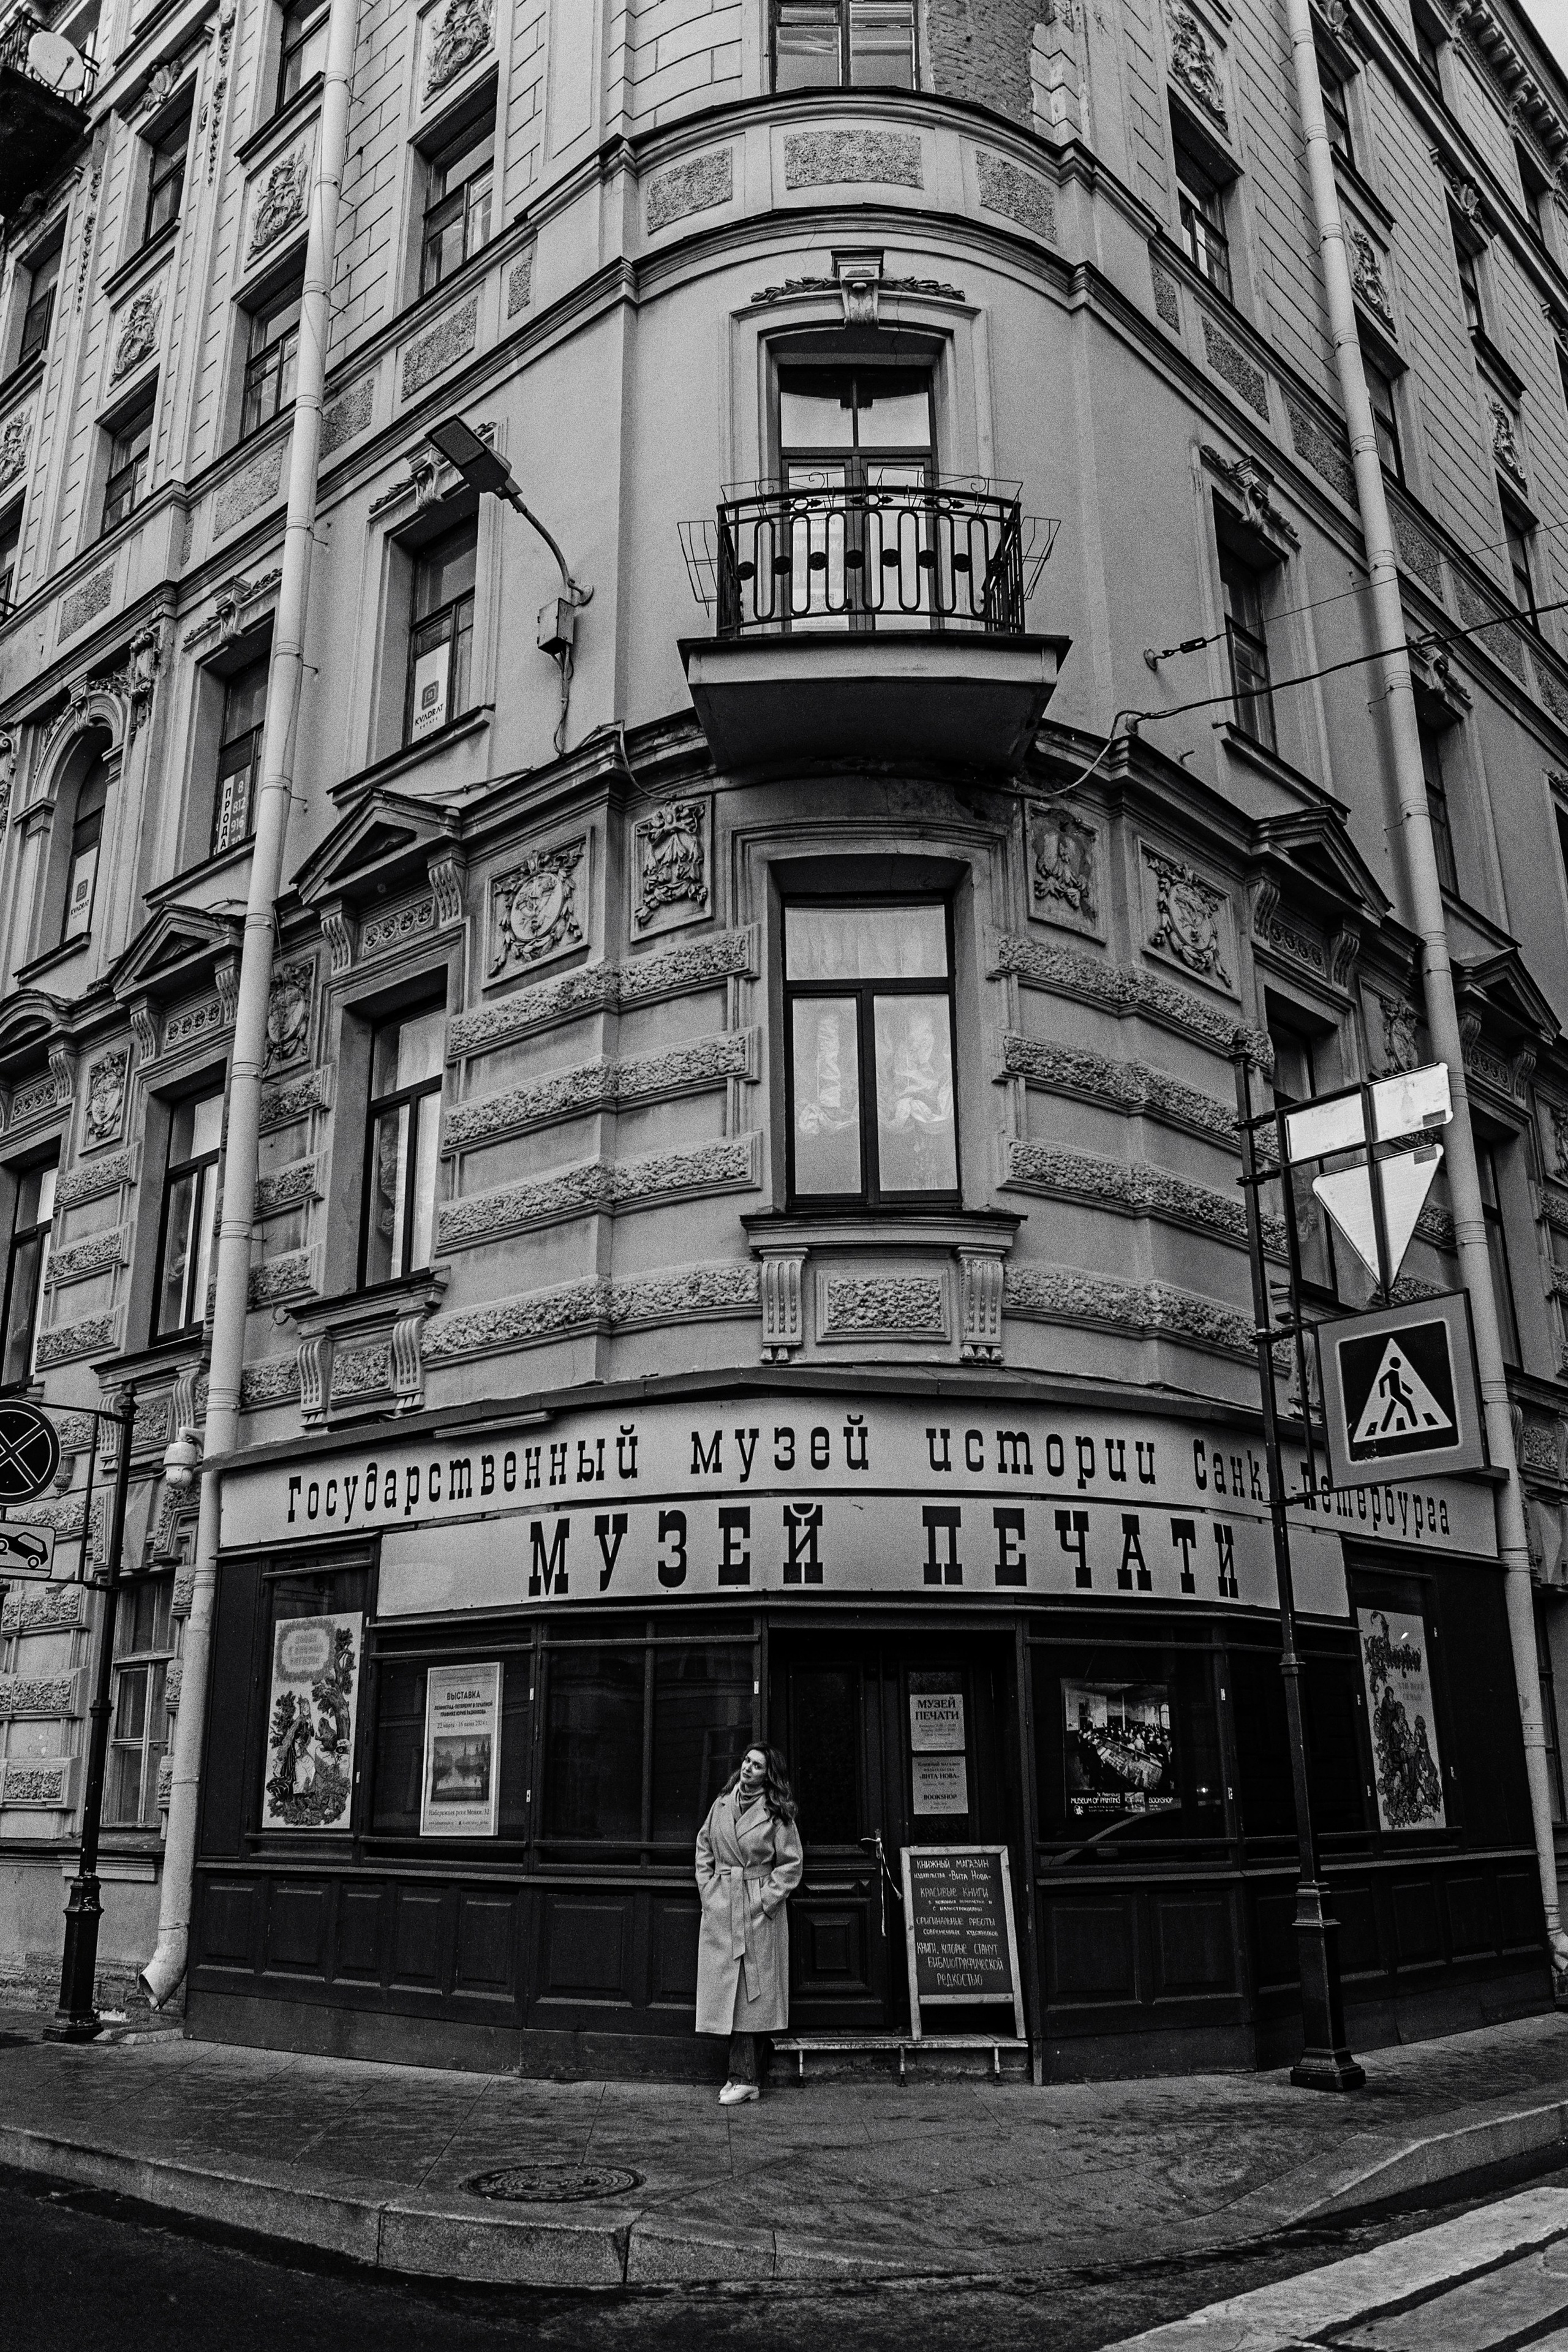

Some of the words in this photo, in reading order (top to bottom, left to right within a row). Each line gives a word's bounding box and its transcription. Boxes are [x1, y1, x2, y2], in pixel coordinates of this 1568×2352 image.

[415, 704, 443, 726] KVADRAT
[238, 780, 244, 794] 8
[232, 797, 246, 814] 812
[230, 815, 244, 833] 916
[70, 899, 89, 916] KVADRAT
[287, 1425, 638, 1524] Государственный
[691, 1412, 869, 1482] музей
[926, 1427, 1156, 1489] истории
[1194, 1439, 1450, 1538] Санк-Петербурга
[529, 1502, 824, 1596] МУЗЕЙ
[922, 1506, 1239, 1599] ПЕЧАТИ
[447, 1689, 481, 1700] ВЫСТАВКА
[918, 1696, 956, 1708] МУЗЕЙ
[915, 1711, 959, 1720] ПЕЧАТИ
[916, 1858, 951, 1869] КНИЖНЫЙ
[956, 1859, 989, 1869] МАГАЗИН
[962, 1887, 989, 1898] КНИГИ
[968, 1917, 996, 1926] РАБОТЫ
[973, 1943, 999, 1956] СТАНУТ
